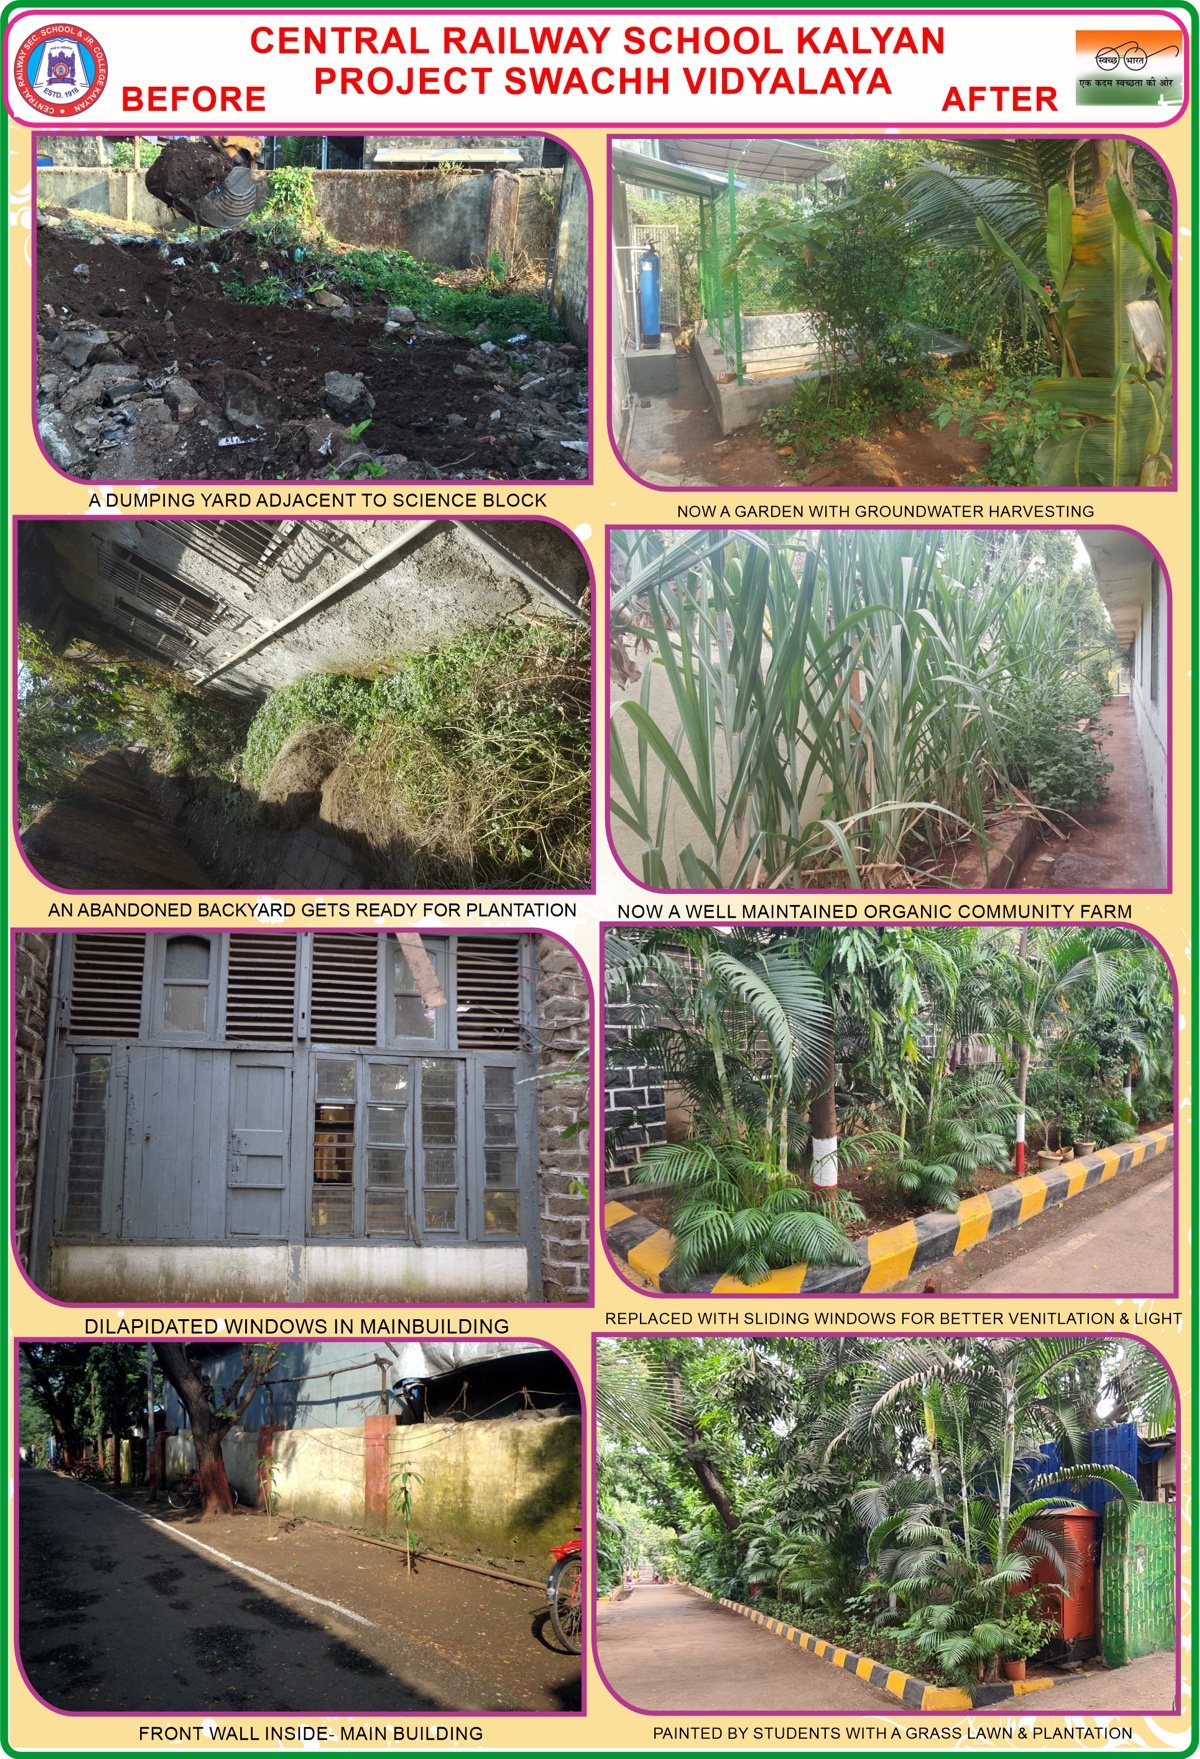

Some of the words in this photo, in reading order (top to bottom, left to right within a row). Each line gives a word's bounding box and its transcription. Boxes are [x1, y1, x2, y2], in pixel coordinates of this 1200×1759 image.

[41, 26, 75, 36] SCHOOL
[24, 35, 40, 50] SEC.
[84, 36, 94, 47] JR.
[250, 26, 430, 54] CENTRAL
[443, 26, 611, 54] RAILWAY
[623, 26, 784, 55] SCHOOL
[797, 26, 944, 54] KALYAN
[16, 50, 27, 87] RAILWAY
[93, 47, 105, 86] COLLEGE
[315, 66, 493, 95] PROJECT
[504, 66, 669, 95] SWACHH
[682, 67, 892, 95] VIDYALAYA
[1079, 79, 1092, 88] एक
[1095, 79, 1113, 87] कदम
[1116, 79, 1143, 87] स्वच्छता
[1146, 77, 1156, 86] की
[1160, 77, 1173, 86] ओर
[43, 87, 63, 98] ESTD.
[74, 87, 100, 112] KALYAN
[122, 85, 266, 112] BEFORE
[941, 86, 1058, 112] AFTER
[23, 88, 55, 114] CENTRAL
[88, 493, 101, 508] A
[106, 493, 195, 508] DUMPING
[200, 493, 251, 508] YARD
[255, 493, 357, 508] ADJACENT
[361, 493, 387, 508] TO
[393, 493, 477, 508] SCIENCE
[483, 493, 547, 508] BLOCK
[677, 505, 717, 518] NOW
[719, 505, 731, 518] A
[734, 505, 804, 518] GARDEN
[808, 505, 850, 518] WITH
[855, 505, 984, 518] GROUNDWATER
[989, 505, 1094, 518] HARVESTING
[48, 902, 73, 917] AN
[77, 902, 192, 917] ABANDONED
[198, 902, 296, 917] BACKYARD
[301, 902, 350, 917] GETS
[356, 902, 418, 917] READY
[423, 902, 461, 917] FOR
[466, 902, 576, 917] PLANTATION
[618, 904, 664, 919] NOW
[668, 904, 681, 919] A
[685, 904, 737, 919] WELL
[742, 904, 858, 919] MAINTAINED
[864, 904, 952, 919] ORGANIC
[958, 904, 1075, 919] COMMUNITY
[1080, 904, 1132, 919] FARM
[605, 1312, 693, 1325] REPLACED
[697, 1312, 739, 1325] WITH
[744, 1312, 809, 1325] SLIDING
[814, 1312, 896, 1325] WINDOWS
[901, 1312, 935, 1325] FOR
[940, 1312, 1004, 1325] BETTER
[1008, 1312, 1115, 1325] VENITLATION
[1119, 1312, 1130, 1325] &
[1135, 1312, 1183, 1325] LIGHT
[85, 1318, 218, 1335] DILAPIDATED
[224, 1318, 327, 1335] WINDOWS
[334, 1318, 353, 1334] IN
[360, 1318, 509, 1335] MAINBUILDING
[139, 1726, 204, 1741] FRONT
[209, 1726, 260, 1741] WALL
[265, 1726, 335, 1741] INSIDE-
[340, 1726, 387, 1741] MAIN
[393, 1726, 483, 1741] BUILDING
[653, 1727, 723, 1740] PAINTED
[728, 1727, 749, 1740] BY
[753, 1727, 841, 1740] STUDENTS
[845, 1727, 887, 1740] WITH
[890, 1727, 902, 1740] A
[905, 1727, 962, 1740] GRASS
[967, 1727, 1013, 1740] LAWN
[1017, 1727, 1028, 1740] &
[1033, 1727, 1132, 1740] PLANTATION
